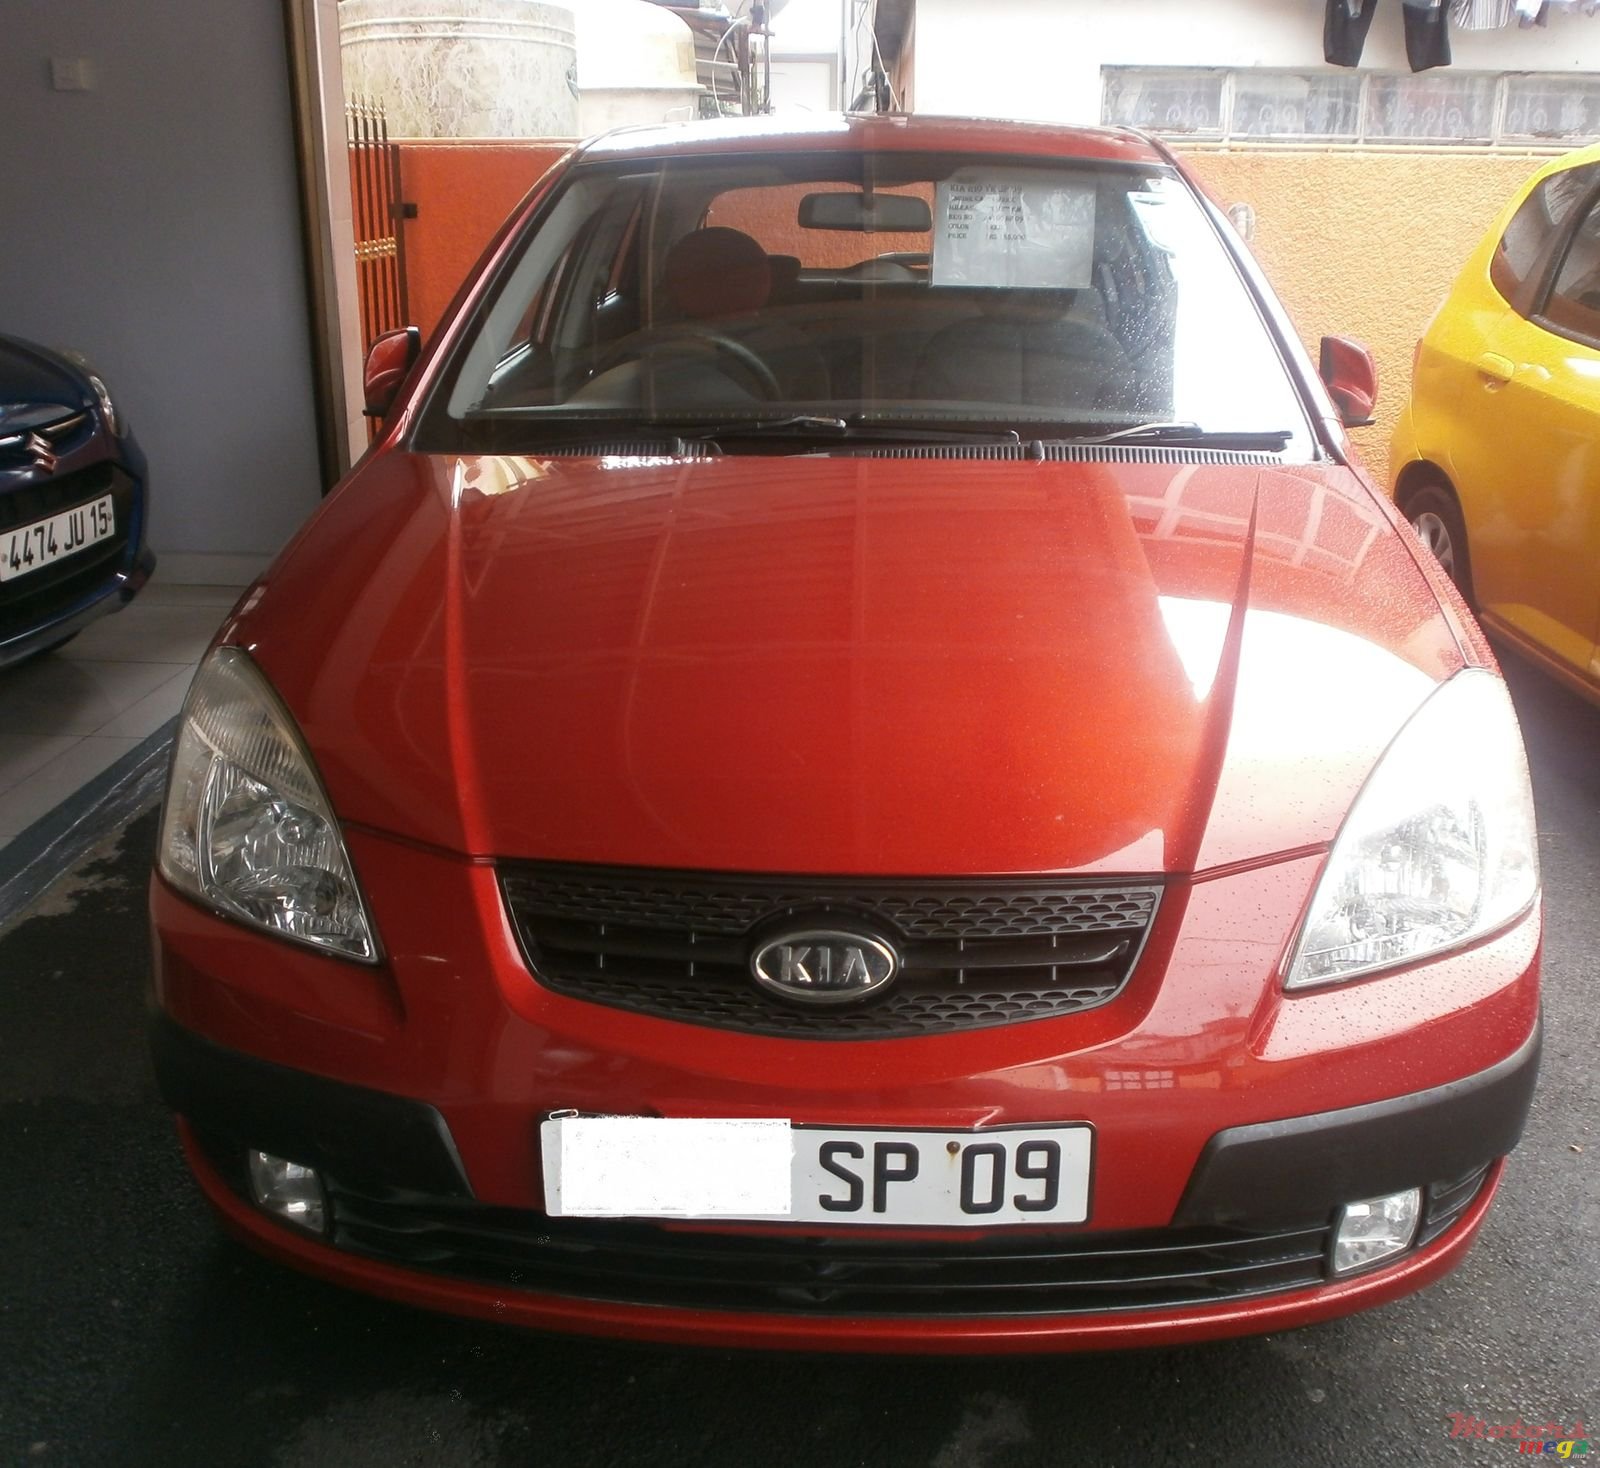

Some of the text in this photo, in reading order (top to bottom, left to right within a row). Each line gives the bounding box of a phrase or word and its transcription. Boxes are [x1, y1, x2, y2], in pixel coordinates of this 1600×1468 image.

[9, 501, 108, 571] 4474 JU 15
[779, 945, 872, 984] KIA
[818, 1139, 1062, 1215] SP 09
